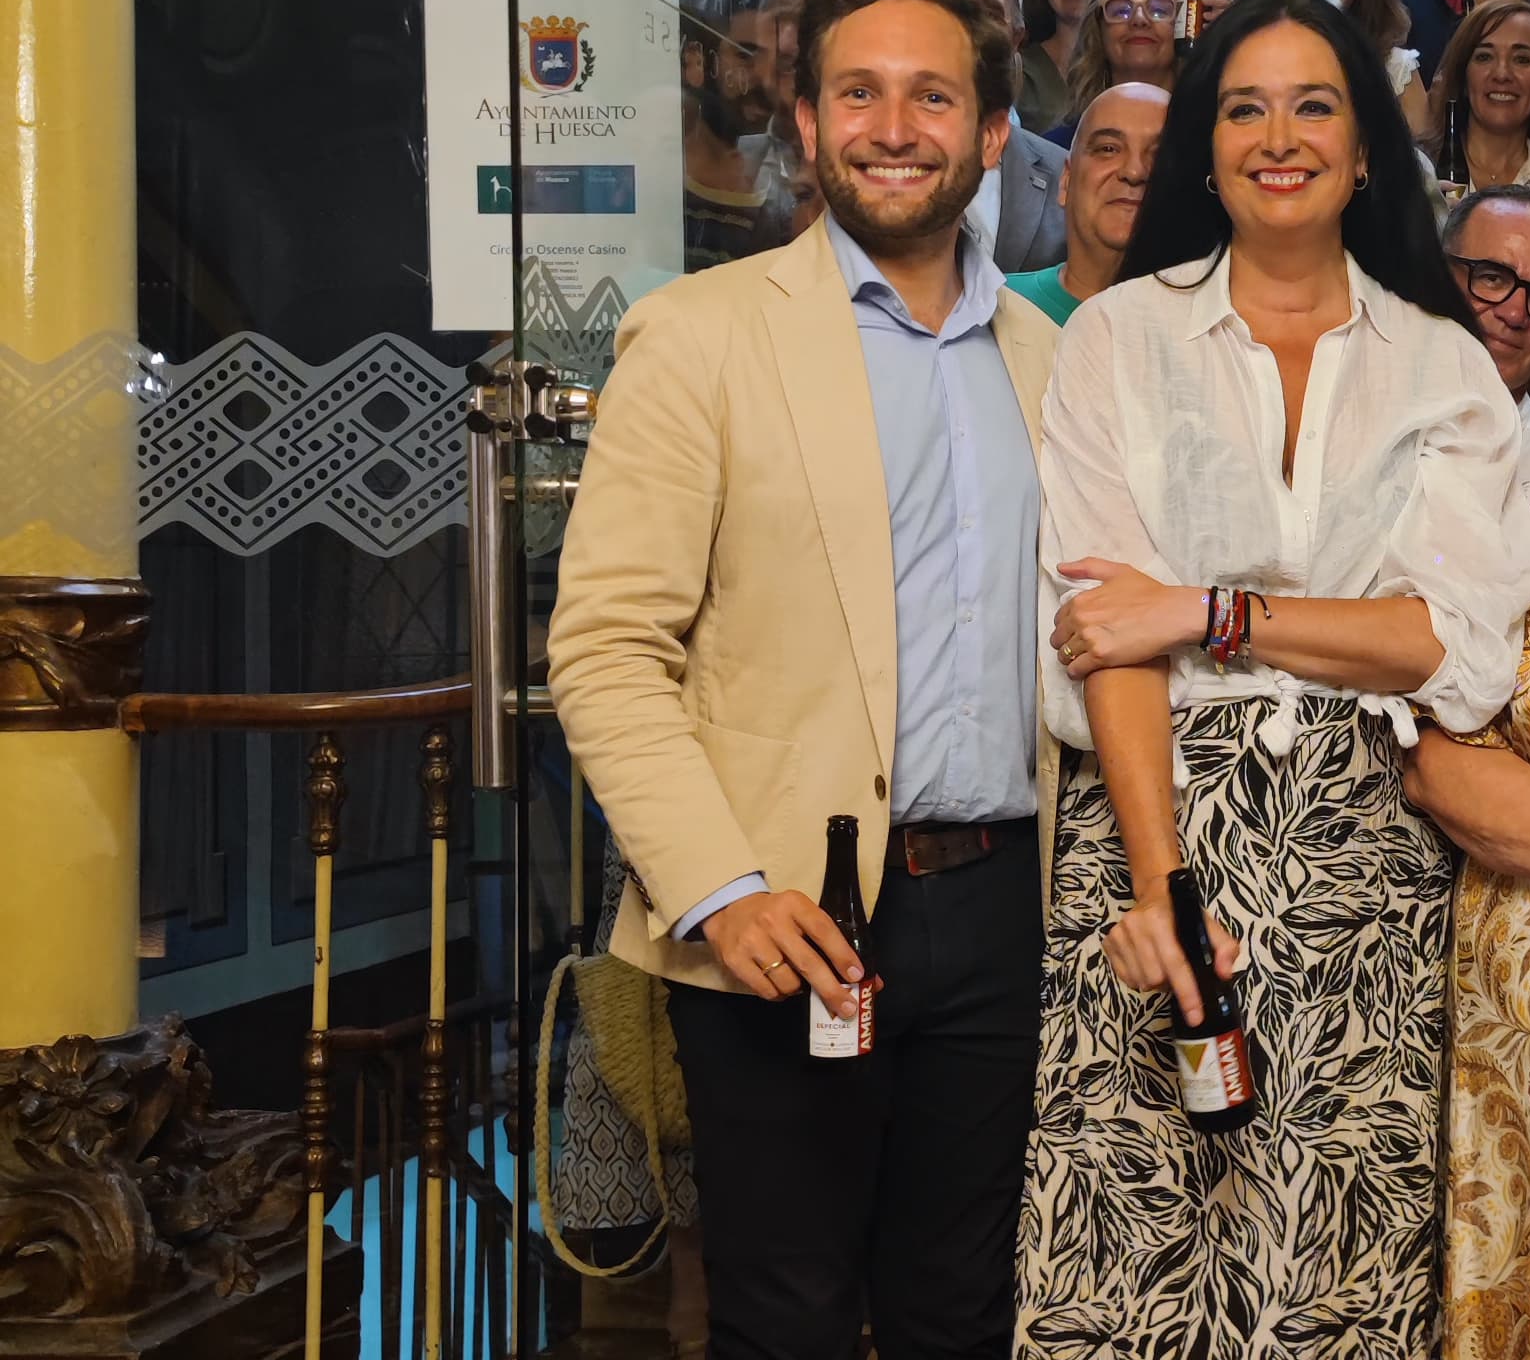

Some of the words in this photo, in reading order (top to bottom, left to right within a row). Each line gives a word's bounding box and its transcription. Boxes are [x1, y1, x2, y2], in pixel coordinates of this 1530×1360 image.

[534, 123, 616, 144] HUESCA
[536, 244, 585, 256] Oscense
[588, 244, 627, 256] Casino
[860, 983, 873, 1050] AMBAR
